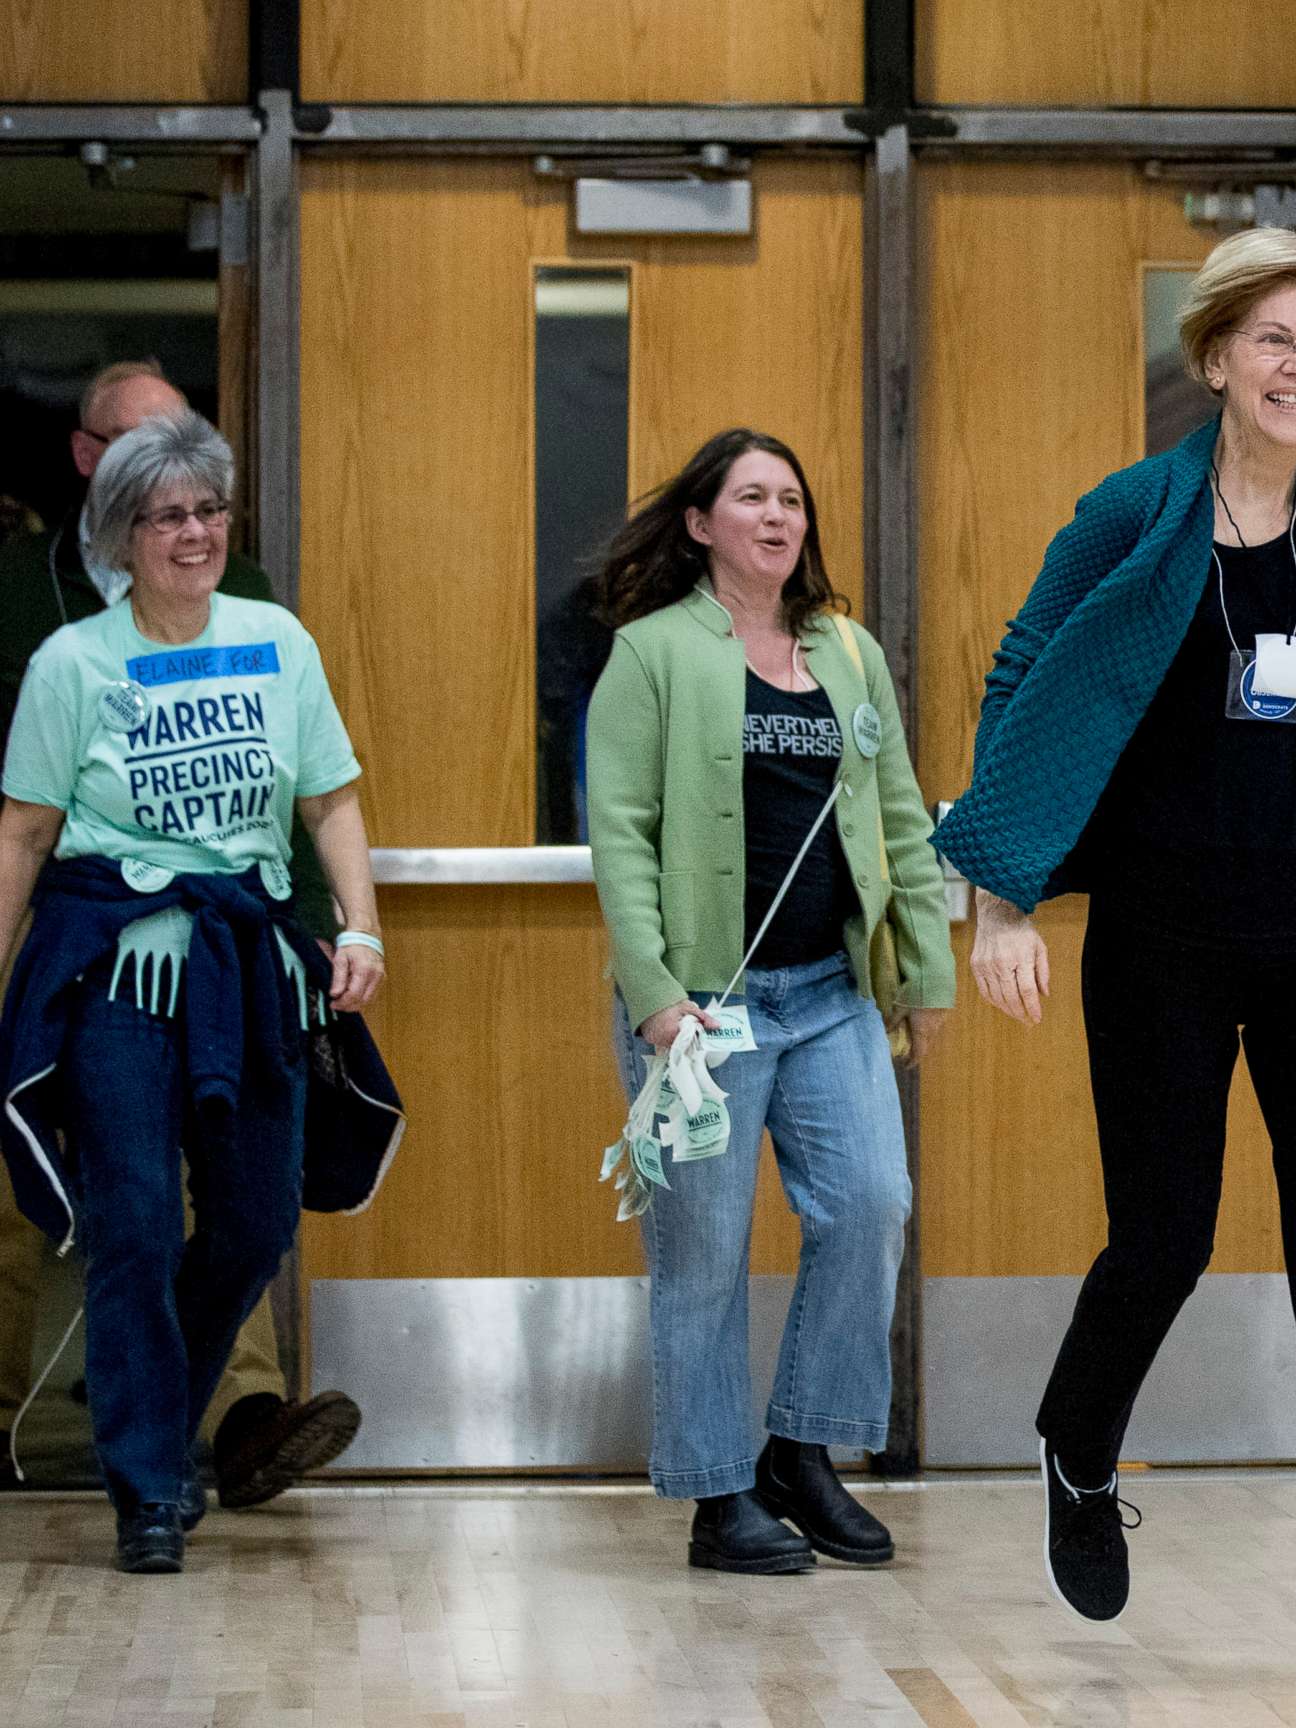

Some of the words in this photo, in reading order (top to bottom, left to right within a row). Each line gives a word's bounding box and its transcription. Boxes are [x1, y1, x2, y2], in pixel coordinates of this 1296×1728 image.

[135, 653, 217, 682] ELAINE
[231, 650, 264, 672] FOR
[127, 692, 265, 750] WARREN
[744, 714, 839, 736] NEVERTHEL
[742, 733, 776, 753] SHE
[778, 734, 842, 757] PERSIS
[129, 749, 275, 801] PRECINCT
[134, 782, 275, 834] CAPTAIN
[686, 1110, 721, 1128] WARREN
